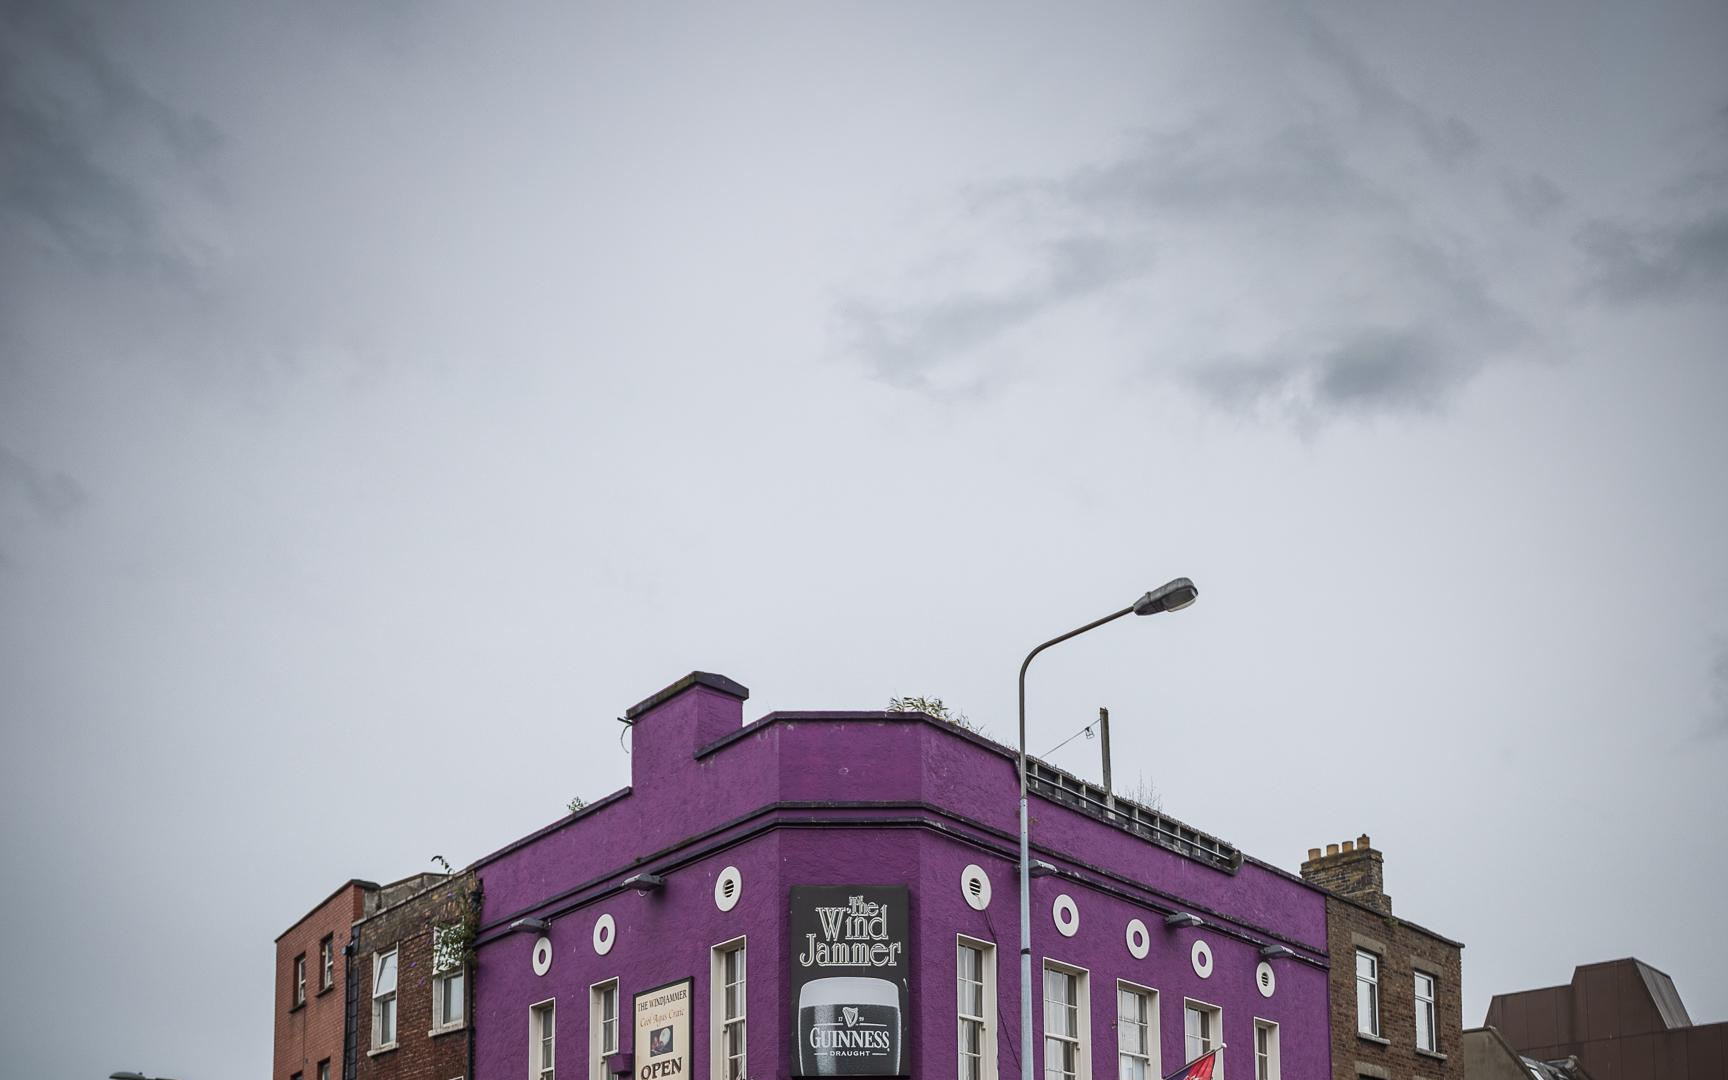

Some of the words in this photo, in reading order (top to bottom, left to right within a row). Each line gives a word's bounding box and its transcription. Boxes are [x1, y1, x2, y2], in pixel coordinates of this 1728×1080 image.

[848, 895, 879, 917] The
[815, 904, 889, 941] Wind
[799, 933, 902, 967] Jammer
[637, 1000, 649, 1012] THE
[649, 989, 687, 1008] WINDJAMMER
[810, 1027, 890, 1050] GUINNESS
